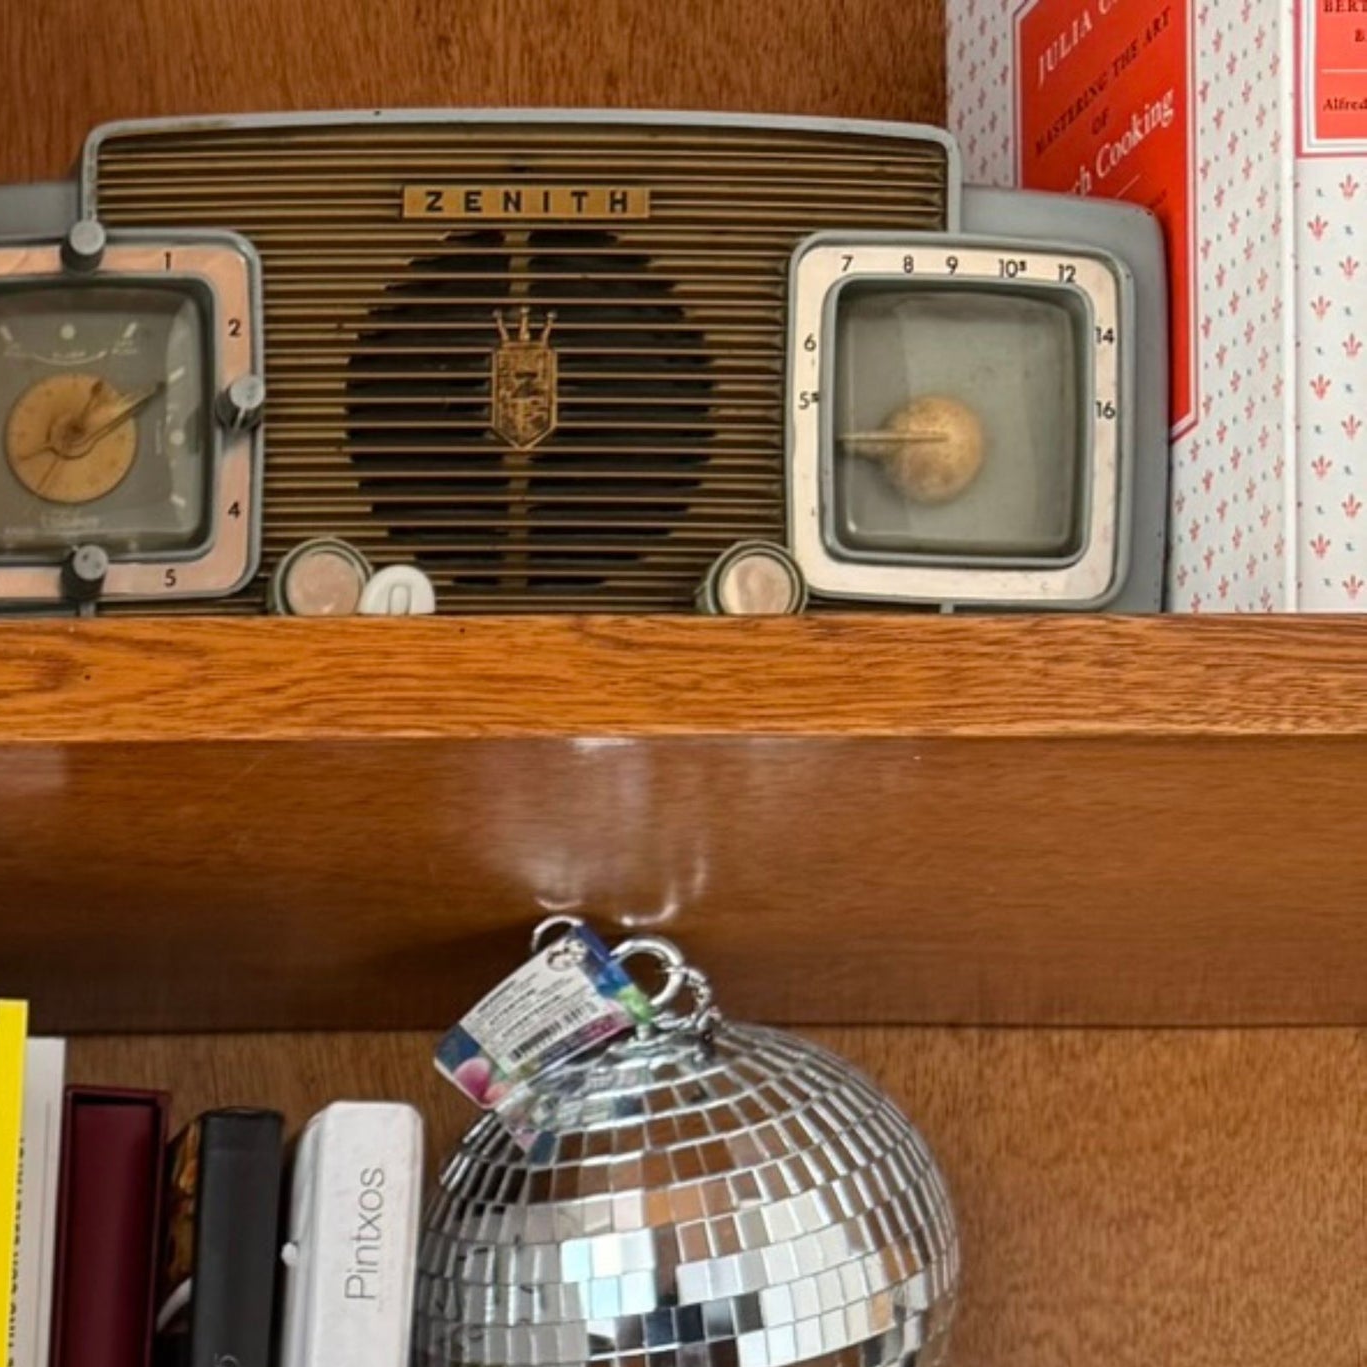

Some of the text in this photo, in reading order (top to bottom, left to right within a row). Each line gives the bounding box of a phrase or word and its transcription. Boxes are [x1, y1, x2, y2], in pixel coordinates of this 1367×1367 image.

[1038, 10, 1093, 89] JULIA
[1091, 107, 1110, 135] OF
[1095, 89, 1175, 180] Cooking
[424, 190, 629, 213] ZENITH
[164, 252, 172, 271] 1
[841, 255, 854, 273] 7
[903, 255, 915, 274] 8
[945, 256, 959, 275] 9
[1057, 263, 1076, 283] 12
[228, 319, 243, 337] 2
[1095, 326, 1116, 345] 14
[803, 333, 817, 352] 6
[1095, 401, 1116, 420] 16
[228, 501, 242, 520] 4
[164, 568, 177, 587] 5
[344, 1167, 386, 1300] Pintxos
